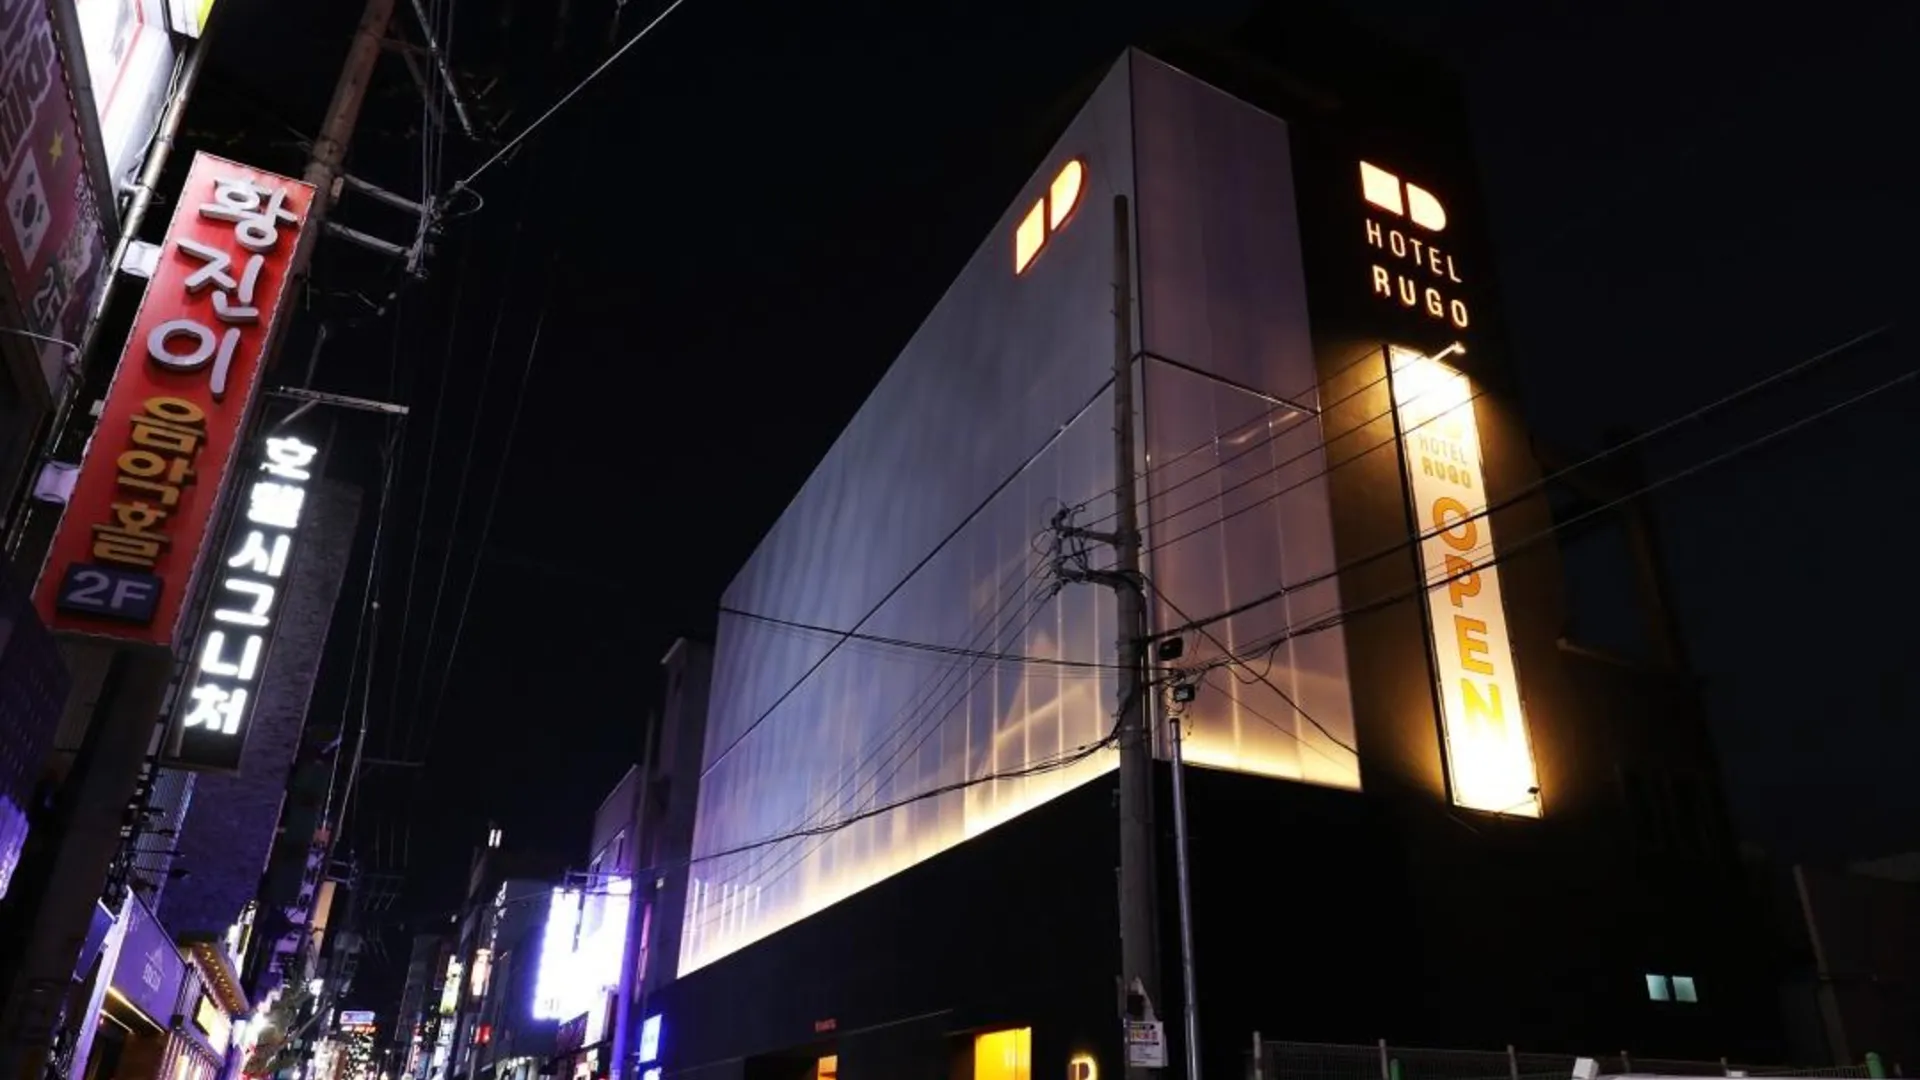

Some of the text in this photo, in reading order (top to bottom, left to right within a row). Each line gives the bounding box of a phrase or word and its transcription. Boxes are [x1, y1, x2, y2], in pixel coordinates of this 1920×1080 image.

[1365, 218, 1462, 283] HOTEL
[146, 176, 298, 398] 황진이
[1372, 264, 1469, 328] RUGO
[1419, 432, 1469, 464] HOTEL
[1421, 455, 1473, 489] RUGO
[93, 396, 206, 566] 음악홀
[66, 569, 153, 610] 2F
[1432, 496, 1506, 738] OPEN
